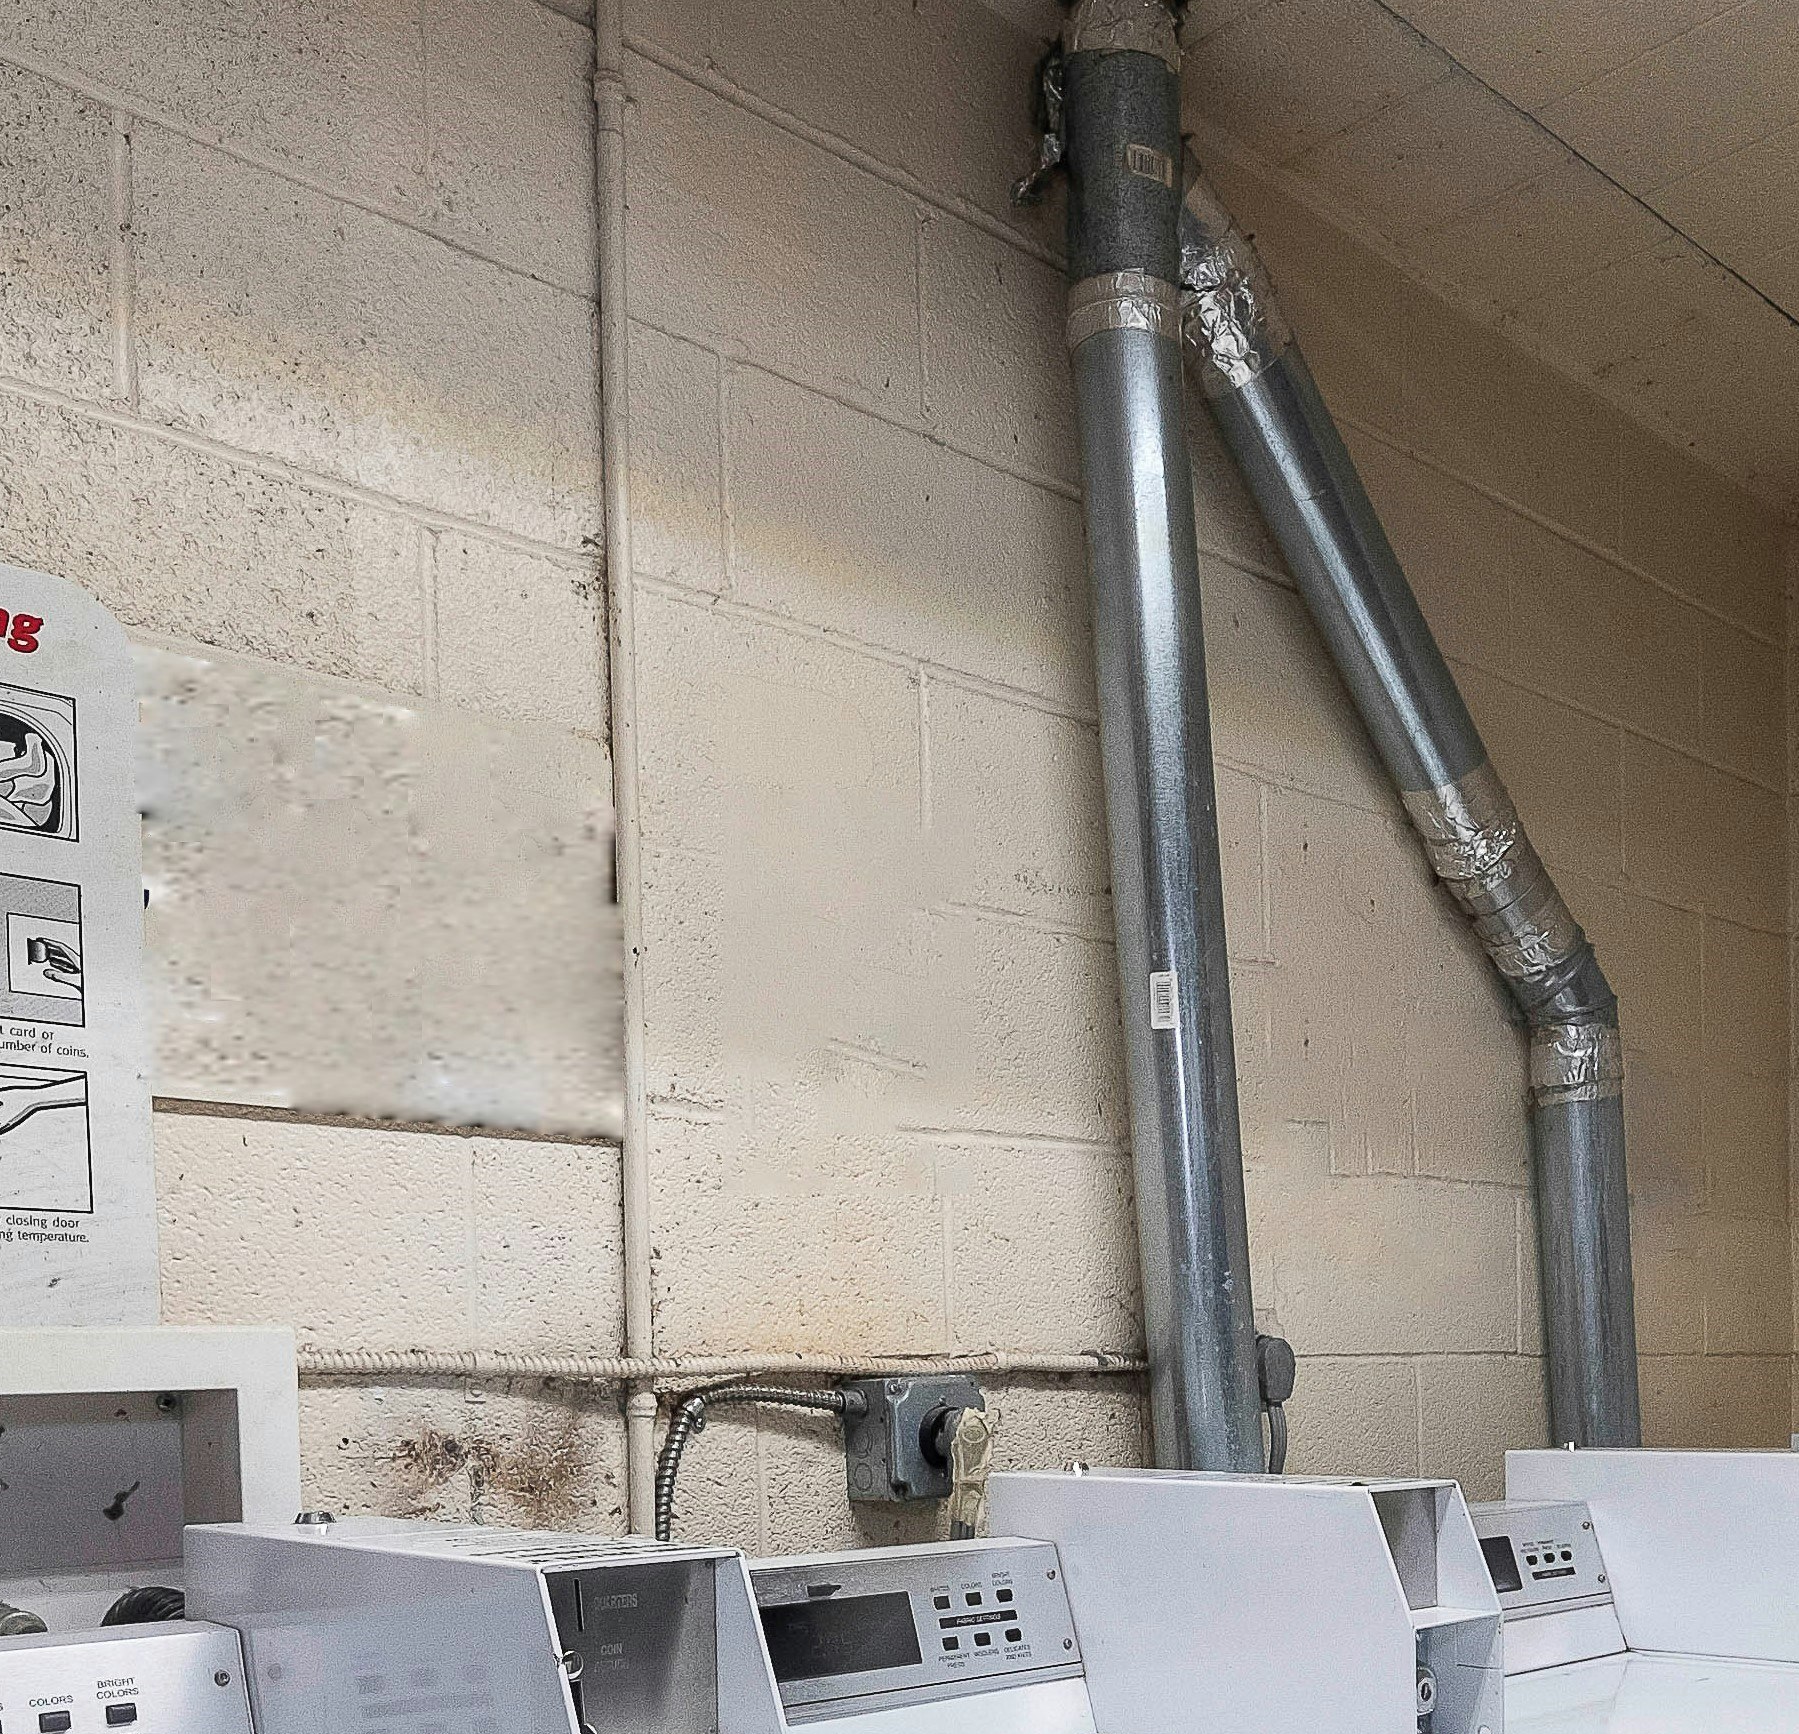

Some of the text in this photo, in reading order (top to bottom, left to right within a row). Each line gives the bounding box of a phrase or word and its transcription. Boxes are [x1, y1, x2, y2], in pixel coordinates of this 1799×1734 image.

[9, 1025, 37, 1038] card
[40, 1030, 54, 1041] or
[39, 1042, 53, 1055] of
[56, 1043, 89, 1059] coins.
[6, 1214, 48, 1229] closing
[52, 1216, 80, 1228] door
[18, 1230, 89, 1243] temperature.
[97, 1677, 136, 1689] BRIGHT
[96, 1687, 139, 1700] COLORS
[29, 1695, 74, 1708] COLORS
